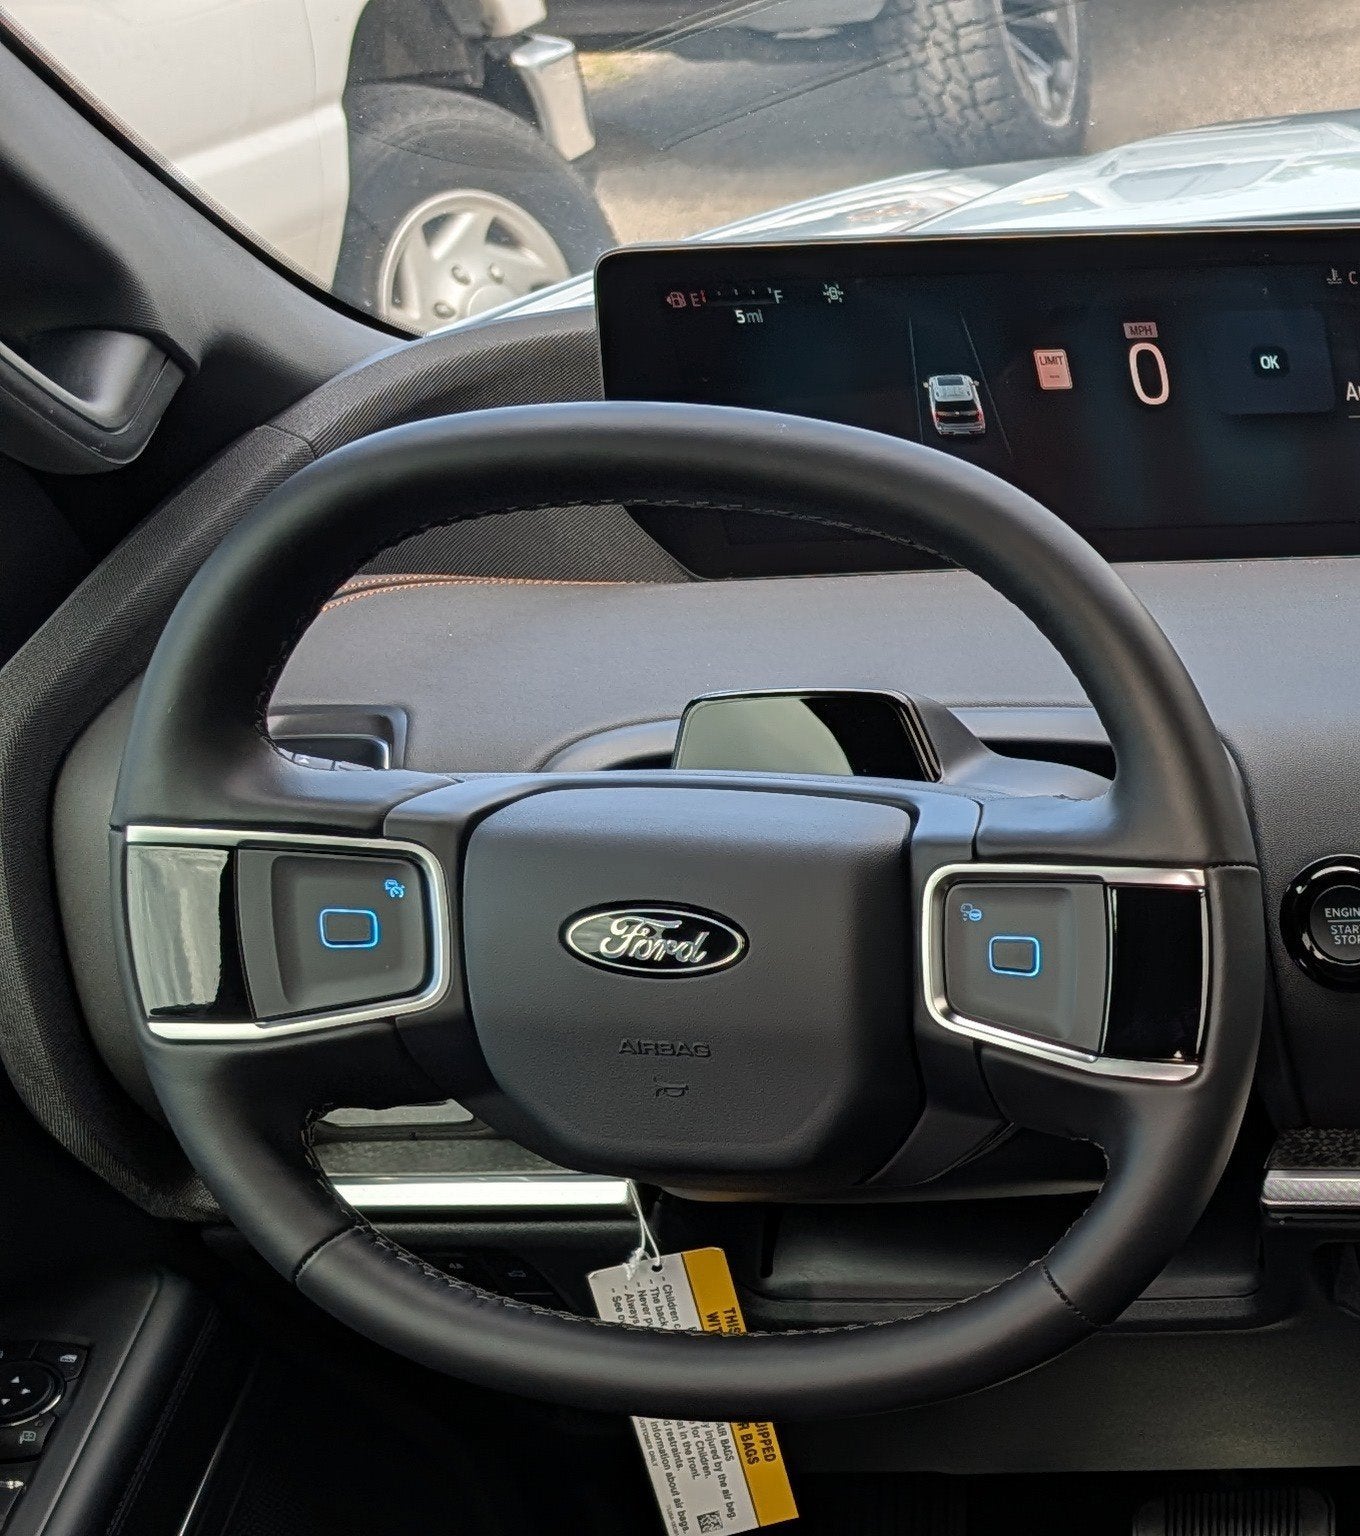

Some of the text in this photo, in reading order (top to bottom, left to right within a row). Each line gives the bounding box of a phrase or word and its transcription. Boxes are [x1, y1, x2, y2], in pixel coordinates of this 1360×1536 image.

[773, 289, 784, 304] F
[1129, 324, 1154, 337] MPH
[1038, 354, 1065, 368] LIMIT
[1259, 355, 1280, 371] OK
[1128, 342, 1170, 407] 0
[599, 915, 709, 964] Ford
[618, 1038, 712, 1059] AIRBAG
[611, 1295, 623, 1313] See
[624, 1293, 640, 1325] Always
[637, 1290, 650, 1316] Never
[650, 1286, 669, 1327] The back
[662, 1284, 679, 1321] Children
[680, 1431, 688, 1440] in
[665, 1428, 684, 1472] restraints.
[683, 1441, 693, 1456] the
[691, 1425, 712, 1479] for Children.
[720, 1439, 734, 1462] BAGS
[741, 1434, 760, 1465] BAGS
[686, 1456, 700, 1480] front.
[714, 1460, 724, 1473] by
[666, 1471, 680, 1497] about
[674, 1497, 684, 1509] air
[718, 1473, 728, 1488] the
[722, 1488, 734, 1501] air
[726, 1501, 737, 1521] bag.
